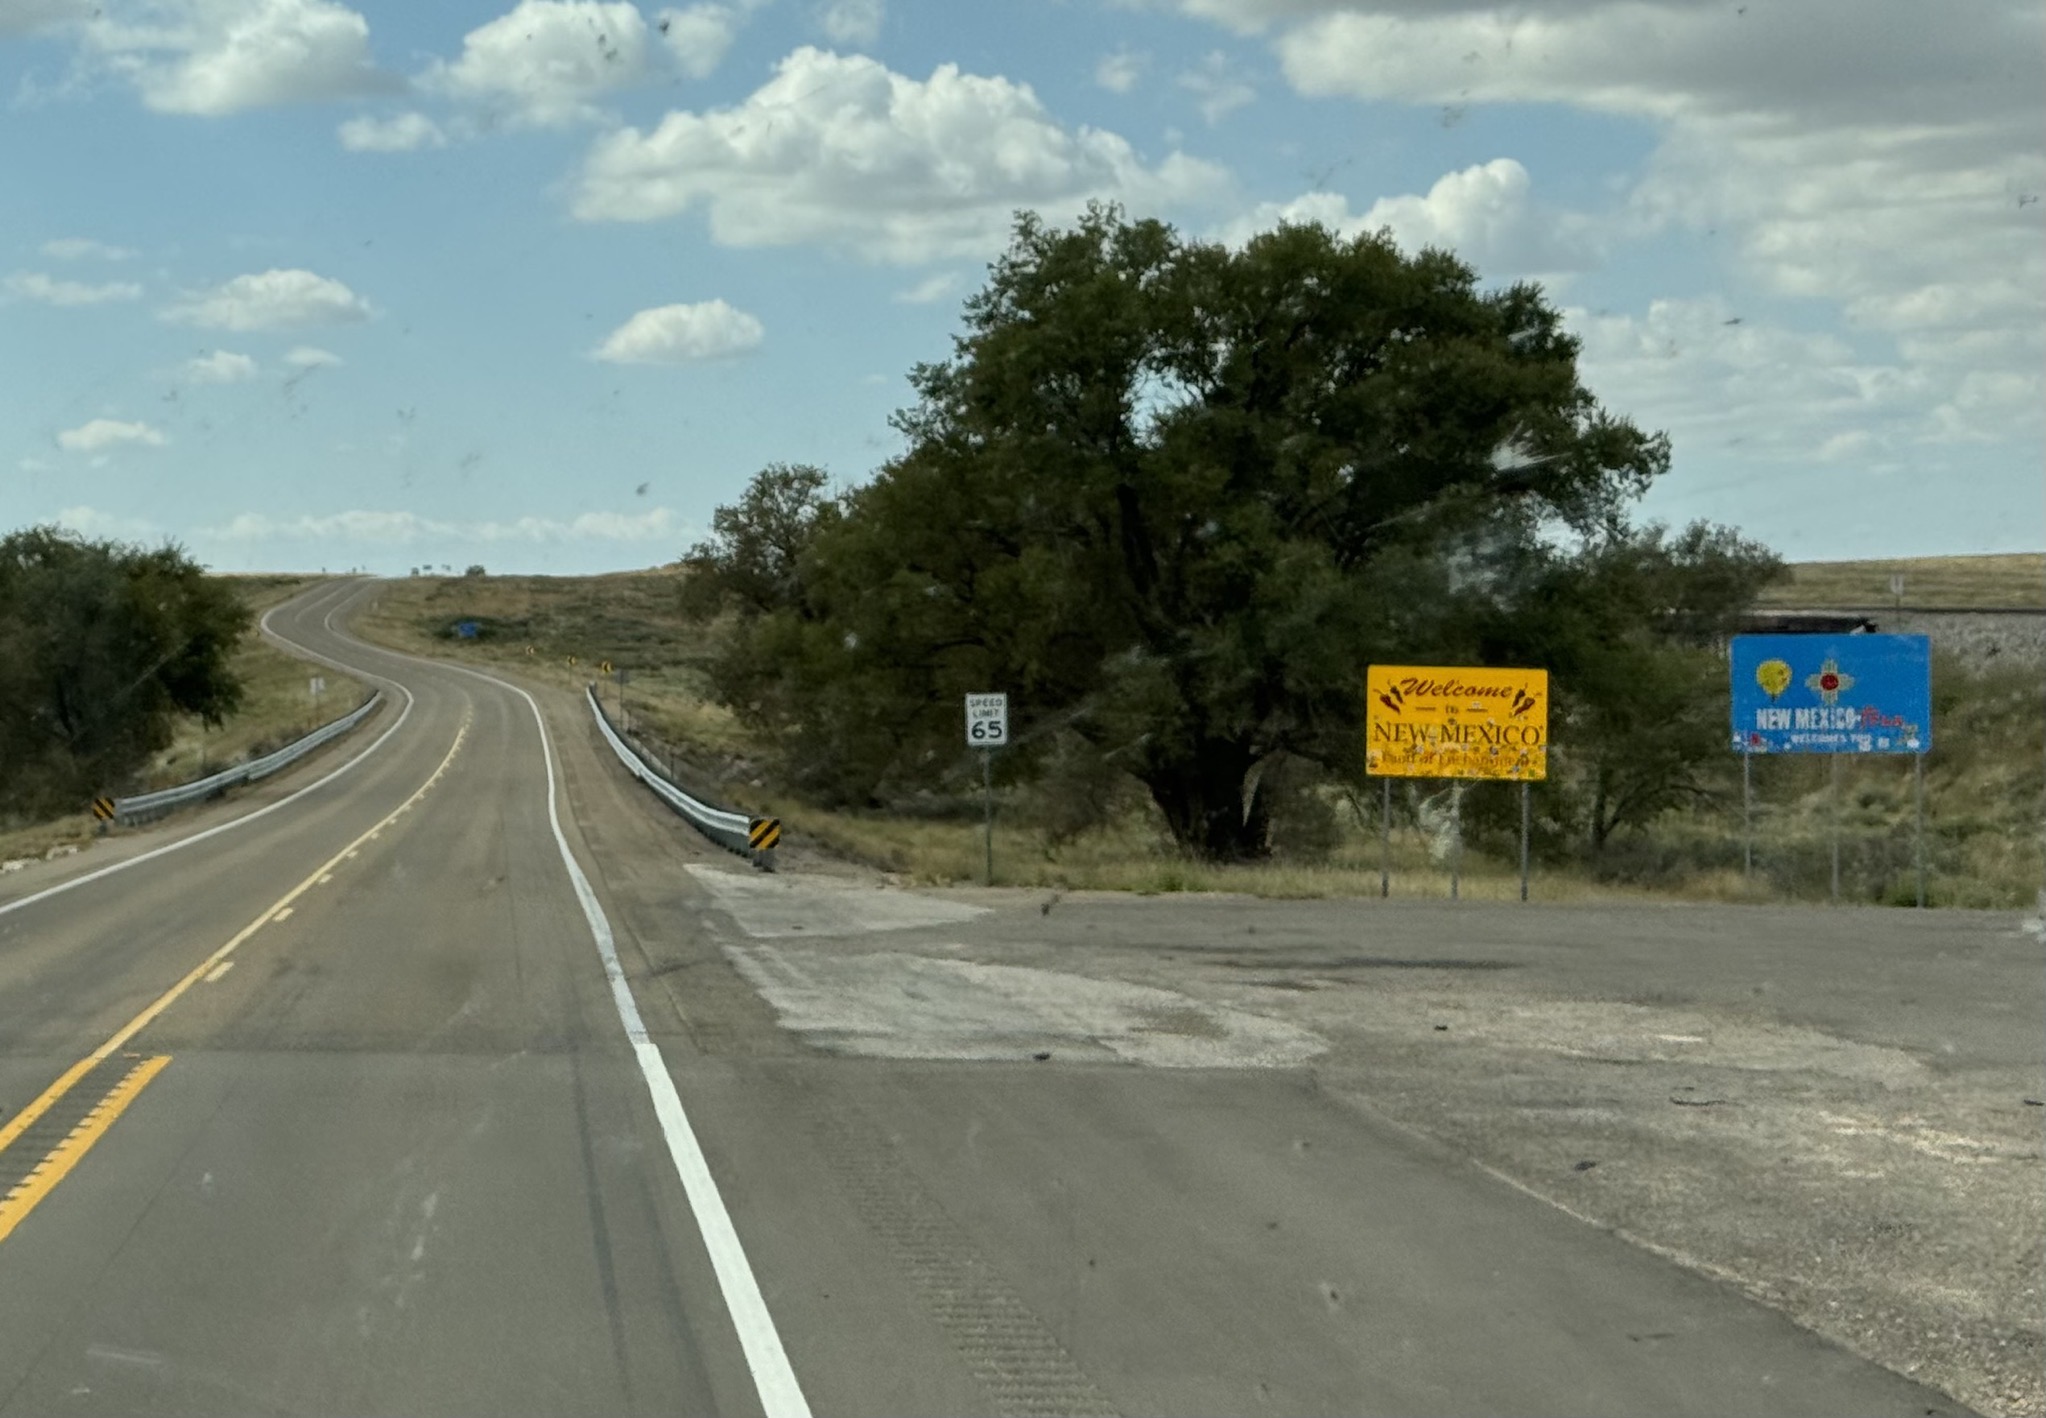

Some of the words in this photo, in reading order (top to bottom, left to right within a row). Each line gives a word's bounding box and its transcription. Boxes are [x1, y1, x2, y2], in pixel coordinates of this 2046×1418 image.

[1400, 677, 1513, 699] Welcome
[970, 698, 1003, 707] SPEED
[972, 709, 1000, 718] LIMIT
[1756, 708, 1792, 730] NEW
[1794, 707, 1856, 730] MEXICO
[971, 720, 1003, 739] 65
[1373, 721, 1430, 742] NEW
[1440, 723, 1540, 745] MEXICO
